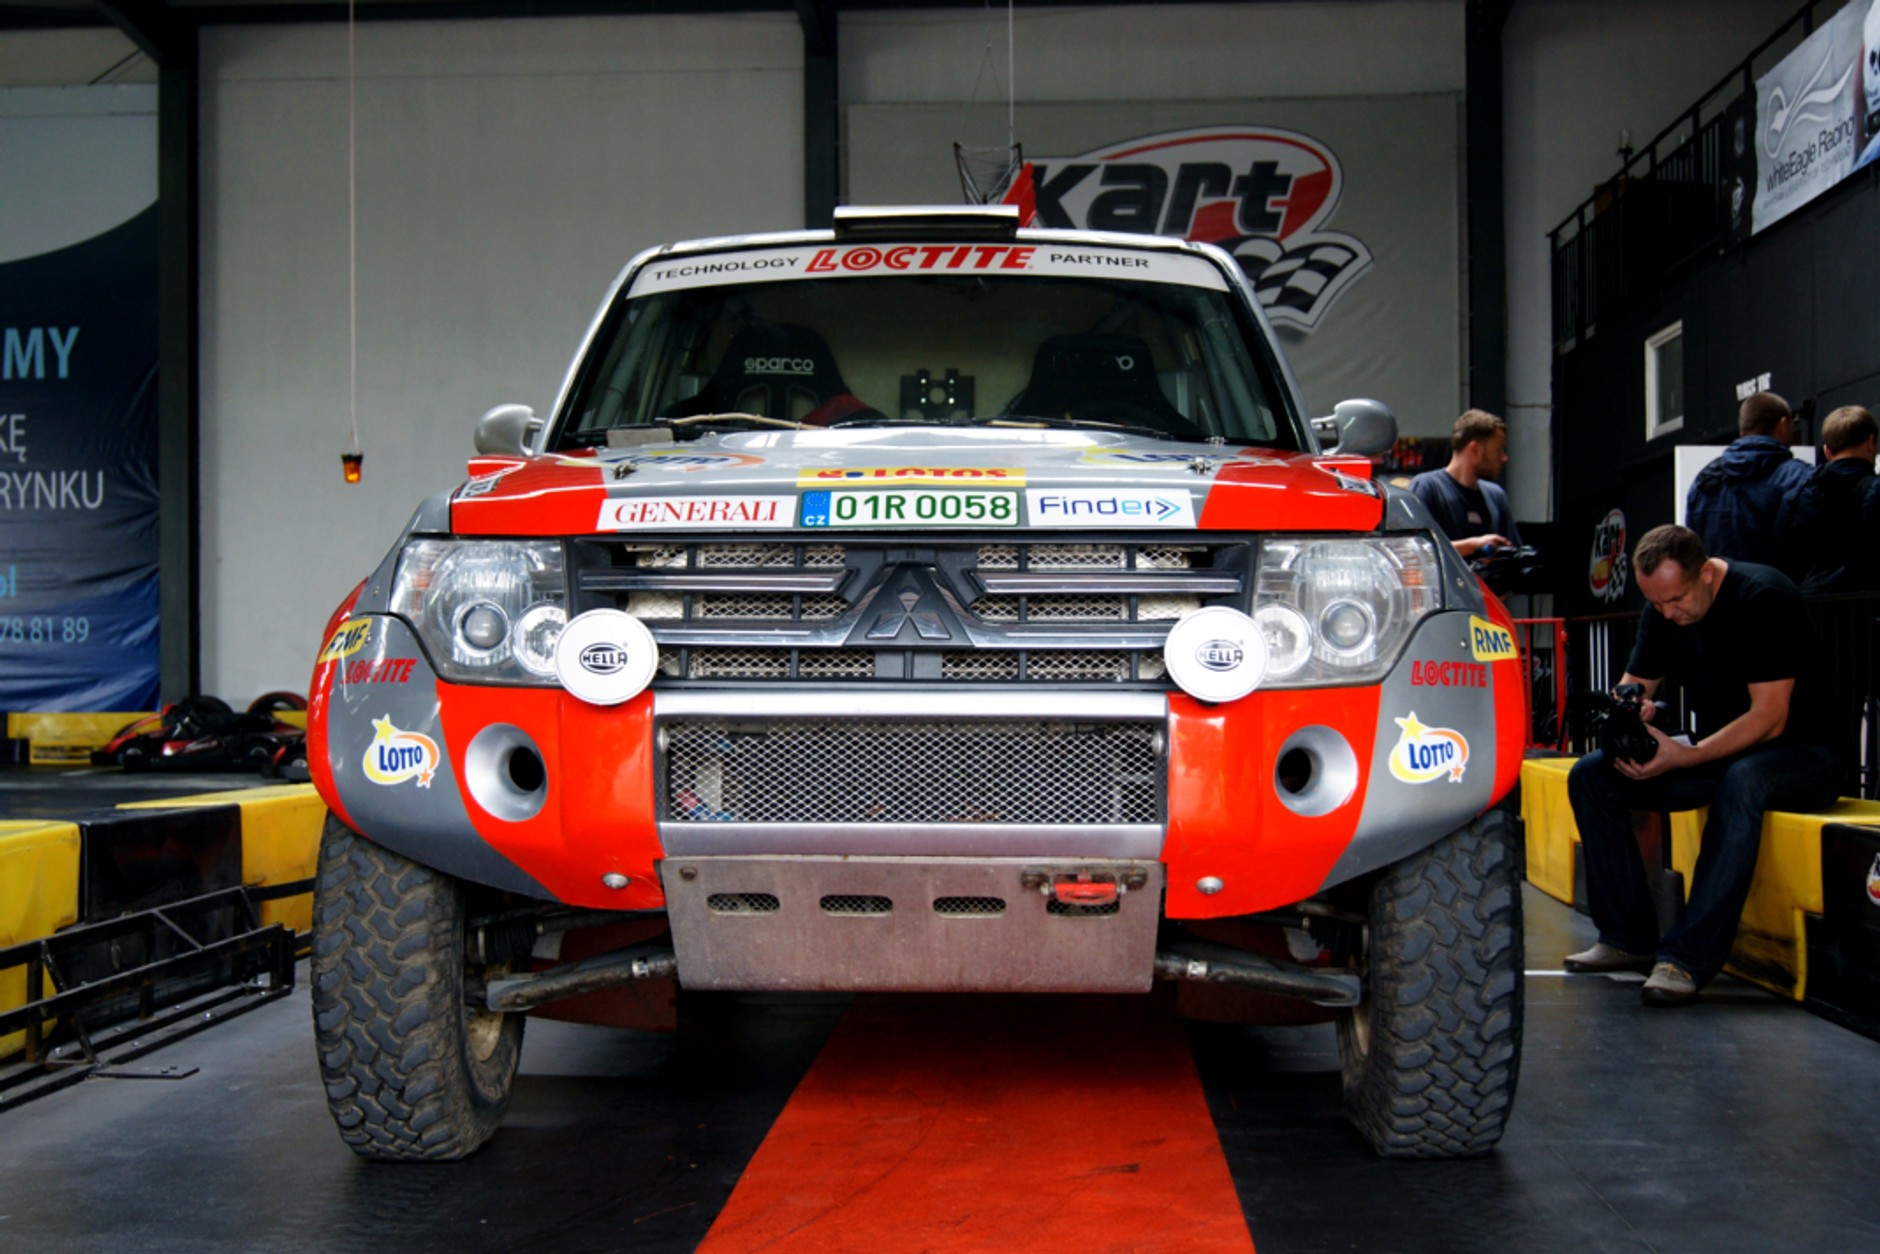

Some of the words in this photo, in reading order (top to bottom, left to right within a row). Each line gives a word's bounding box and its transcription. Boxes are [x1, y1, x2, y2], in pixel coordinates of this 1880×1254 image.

[1818, 116, 1855, 157] Racing
[653, 257, 800, 281] TECHNOLOGY
[804, 246, 1037, 273] LOCTITE
[1050, 252, 1150, 269] PARTNER
[743, 357, 815, 375] sparco
[613, 500, 779, 523] GENERALI
[804, 515, 826, 526] CZ
[835, 494, 907, 520] 01R
[915, 494, 1011, 520] 0058
[30, 616, 54, 644] 81
[62, 616, 90, 644] 89
[1474, 626, 1513, 655] RMF
[581, 650, 628, 666] HELLA
[1198, 649, 1244, 664] HELLA
[340, 658, 418, 685] LOCTITE
[1411, 660, 1488, 688] LOCTITE
[378, 744, 424, 773] LOTTO
[1408, 741, 1454, 770] LOTTO
